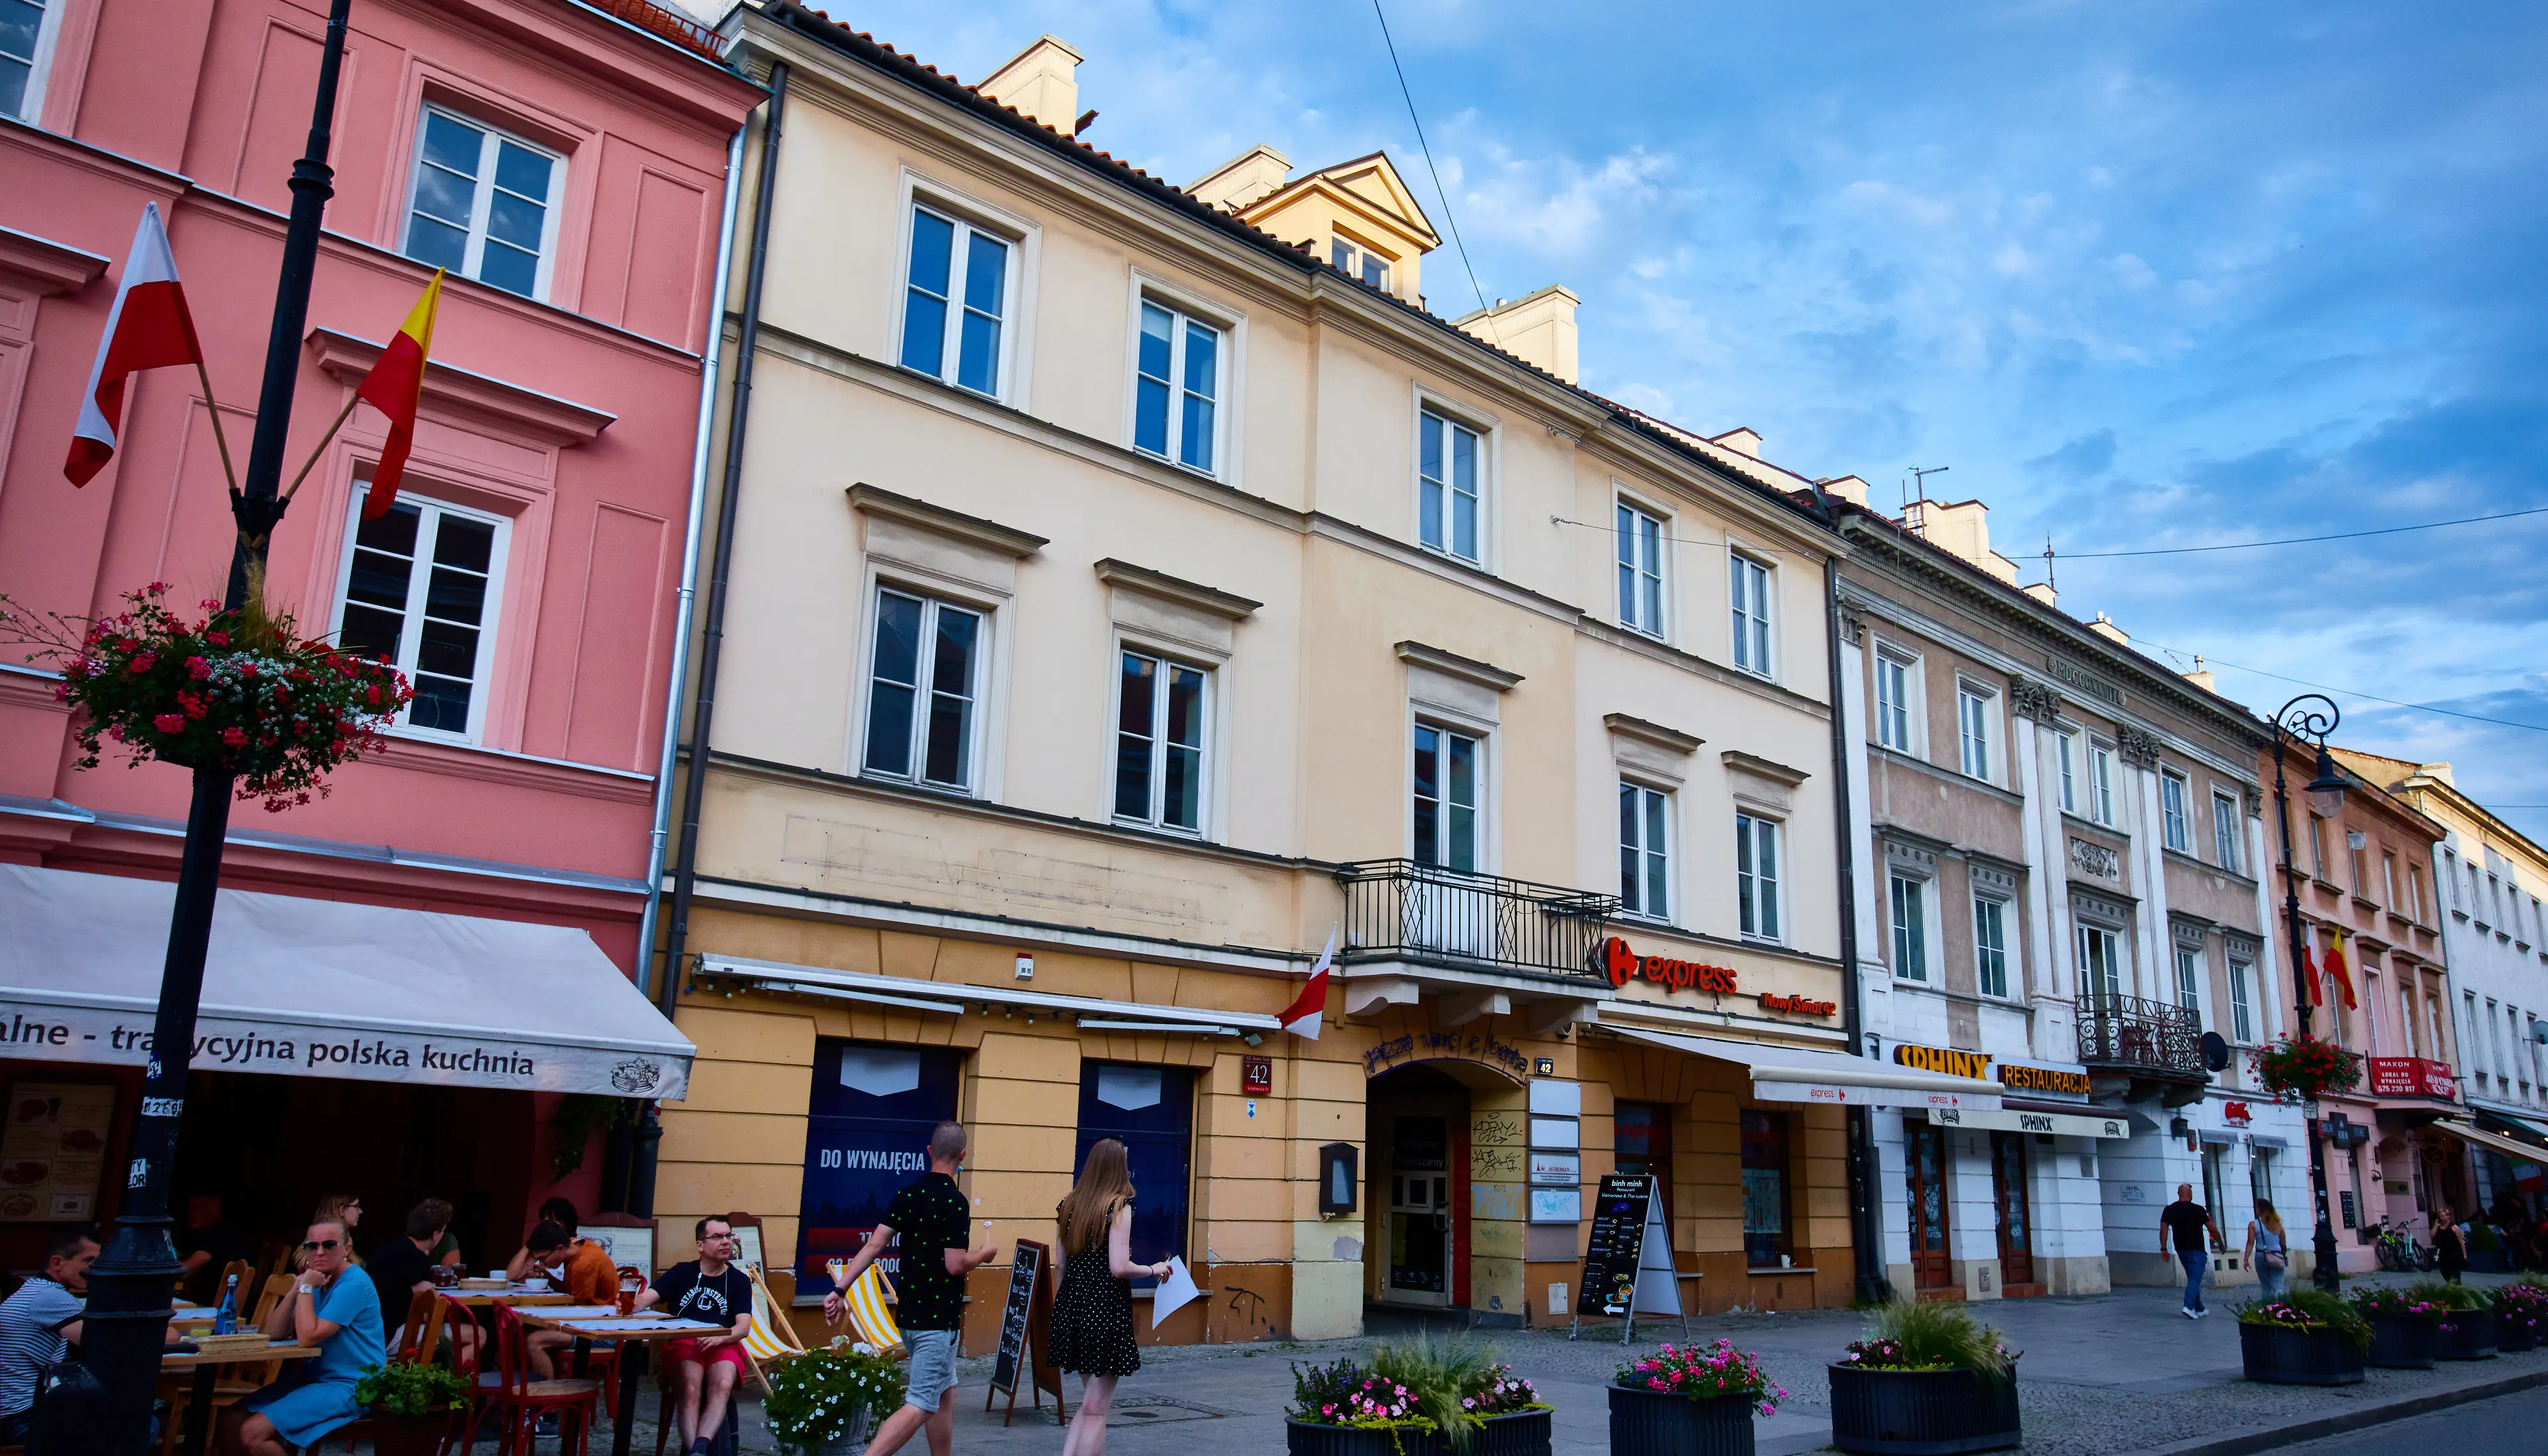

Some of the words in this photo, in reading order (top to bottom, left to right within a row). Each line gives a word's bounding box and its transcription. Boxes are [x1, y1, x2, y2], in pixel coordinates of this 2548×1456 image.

[1645, 956, 1737, 994] express
[1764, 992, 1794, 1014] Nowy
[1794, 994, 1823, 1015] Świat
[1823, 1002, 1837, 1016] 42
[110, 1026, 295, 1064] traycyjna
[307, 1039, 410, 1067] polska
[421, 1044, 534, 1075] kuchnia
[1250, 1065, 1267, 1084] 42
[1540, 1063, 1551, 1073] 42
[1902, 1045, 1988, 1081] SPHINX
[2005, 1065, 2091, 1094] RESTAURACJA
[1810, 1089, 1835, 1099] express
[1928, 1096, 1948, 1106] express
[2020, 1114, 2050, 1132] SPHINX
[820, 1150, 841, 1168] DO
[847, 1150, 925, 1175] WYNAJĘCIA
